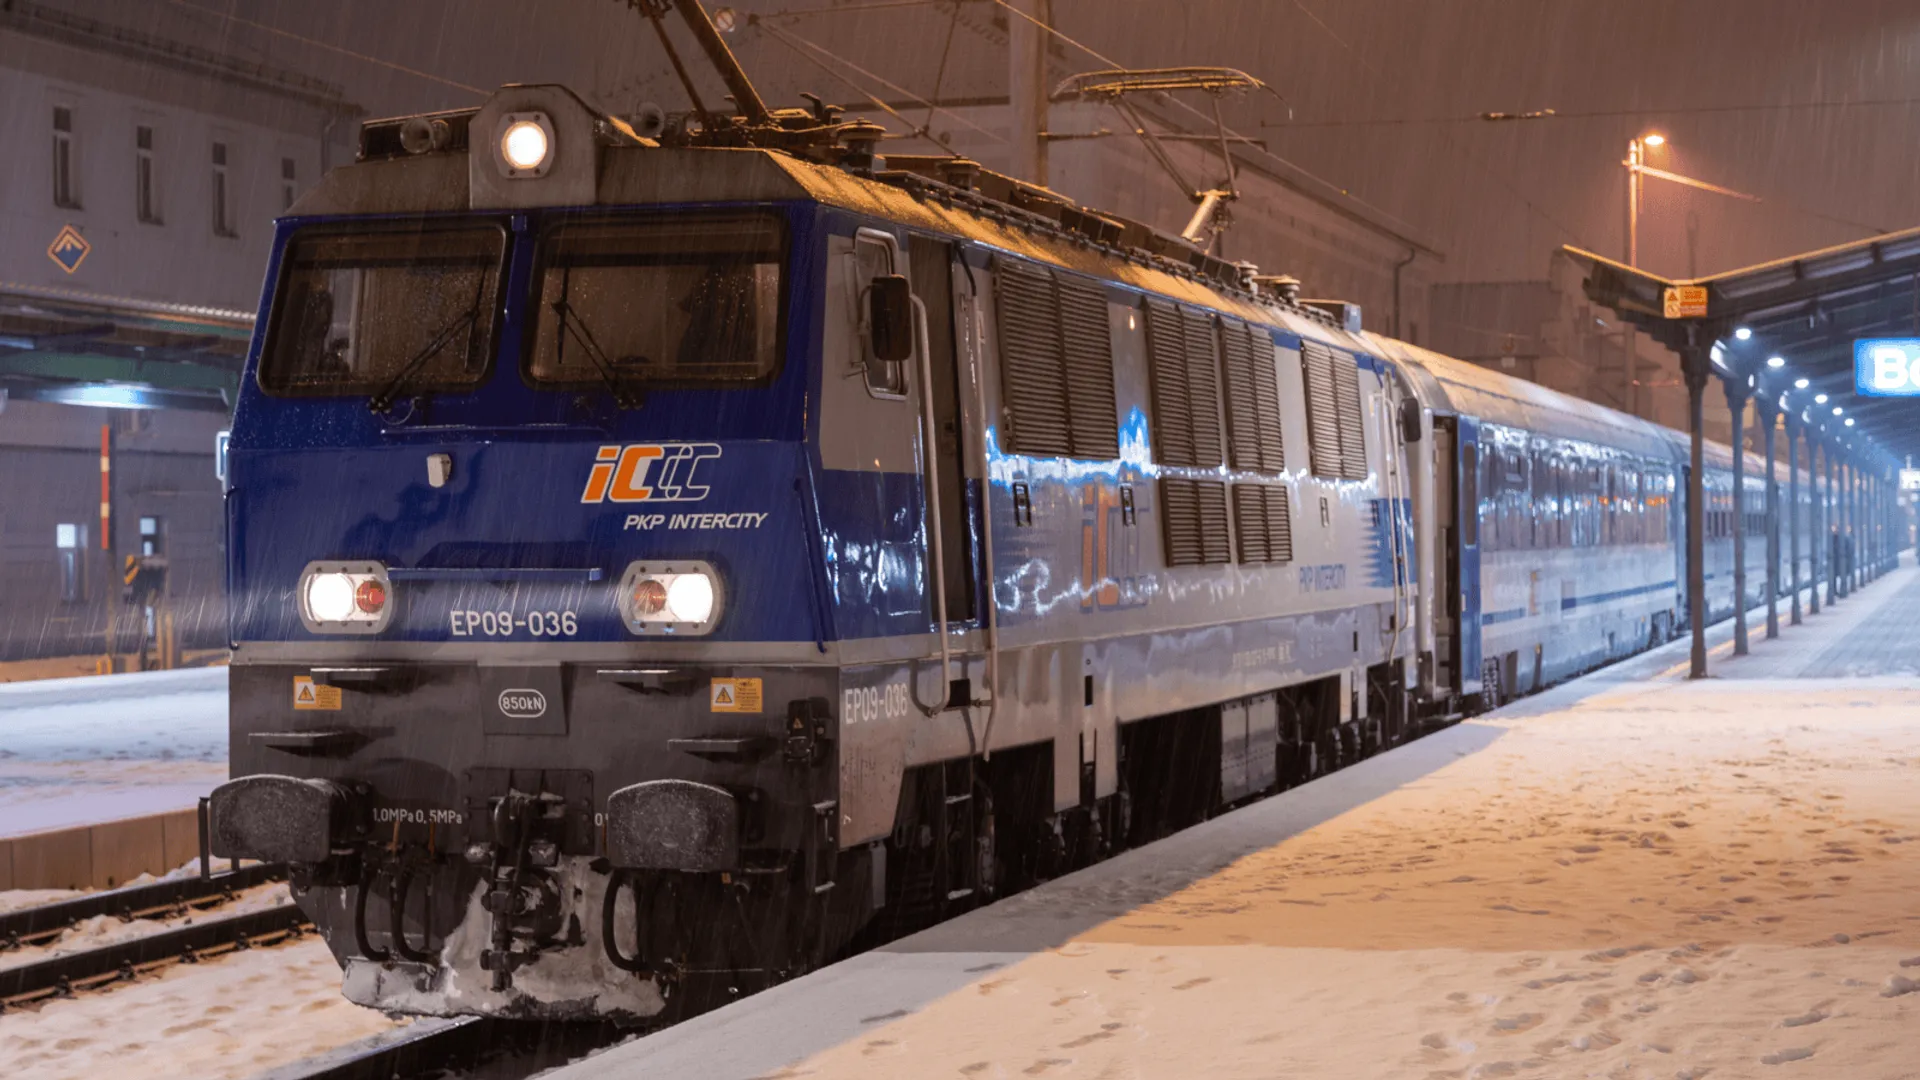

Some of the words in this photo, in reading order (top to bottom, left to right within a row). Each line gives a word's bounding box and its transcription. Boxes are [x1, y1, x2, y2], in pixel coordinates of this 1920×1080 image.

[623, 513, 666, 530] PKP
[668, 511, 769, 530] INTERCITY
[450, 610, 578, 636] EP09-036
[502, 696, 543, 711] 850kN
[844, 683, 908, 725] EP09-036
